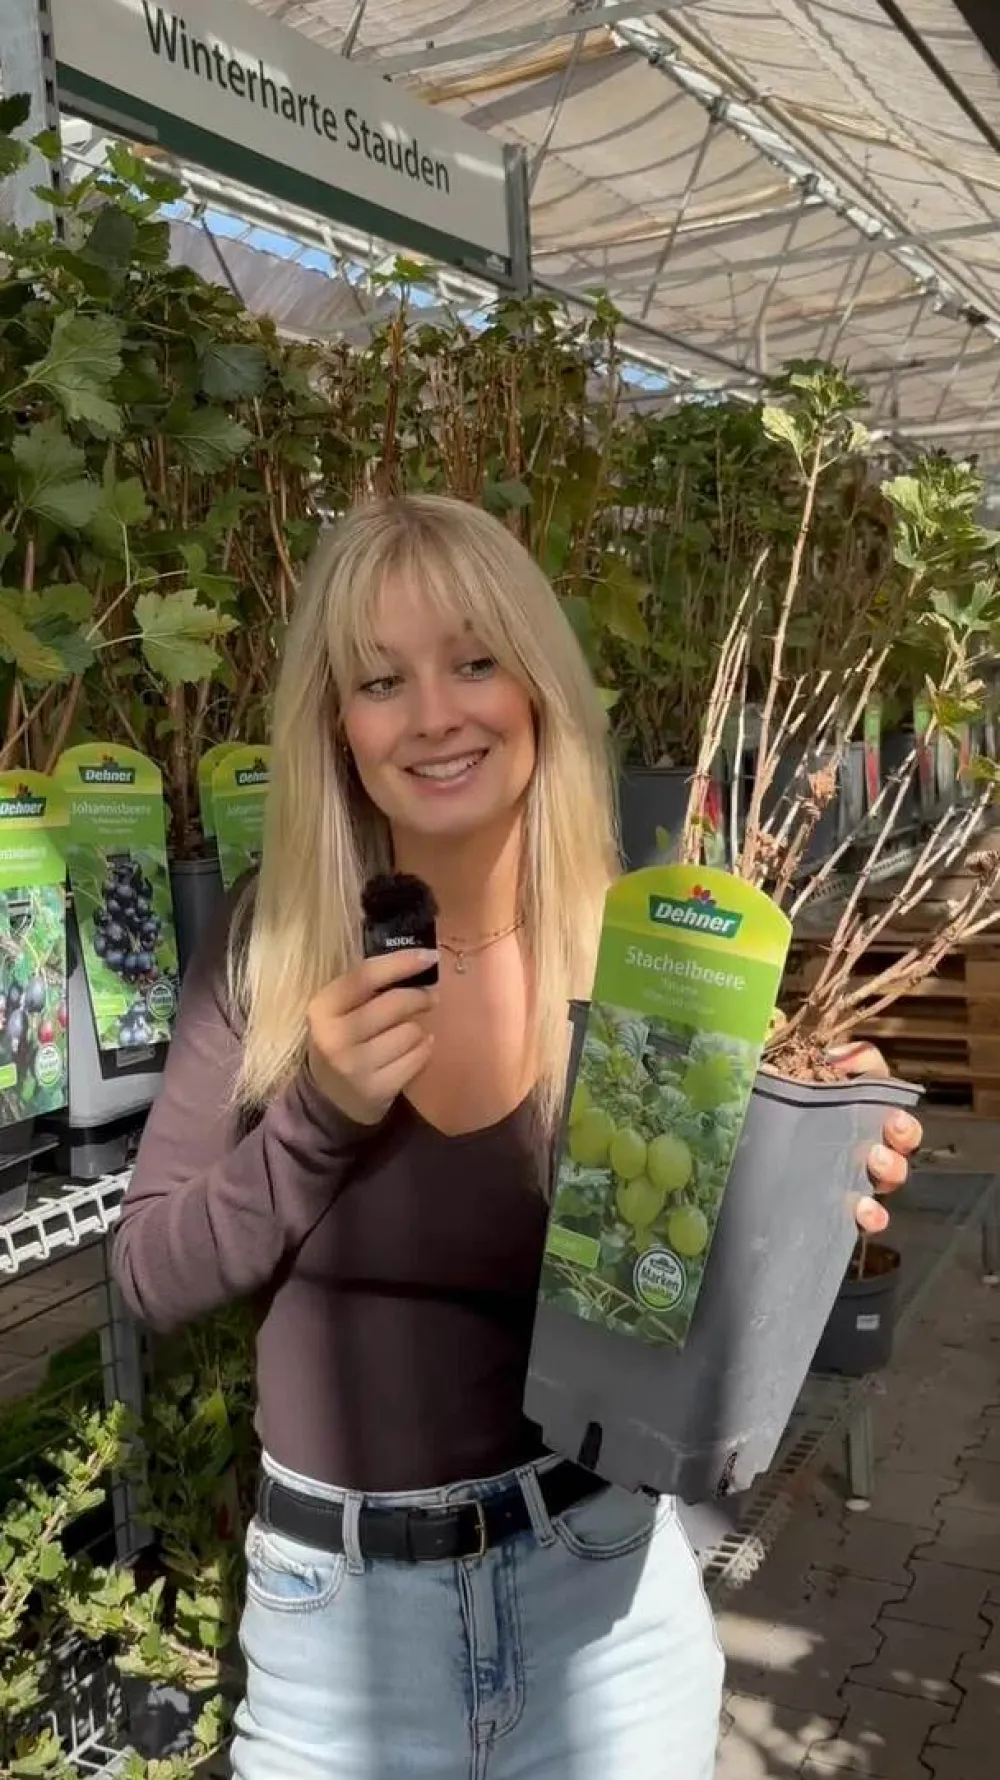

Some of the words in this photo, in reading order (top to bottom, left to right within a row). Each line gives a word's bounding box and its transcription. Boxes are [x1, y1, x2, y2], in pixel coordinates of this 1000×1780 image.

[143, 0, 338, 142] Winterharte
[344, 108, 450, 194] Stauden
[85, 769, 132, 782] Dehner
[0, 801, 43, 815] Dehner
[655, 902, 737, 934] Dehner
